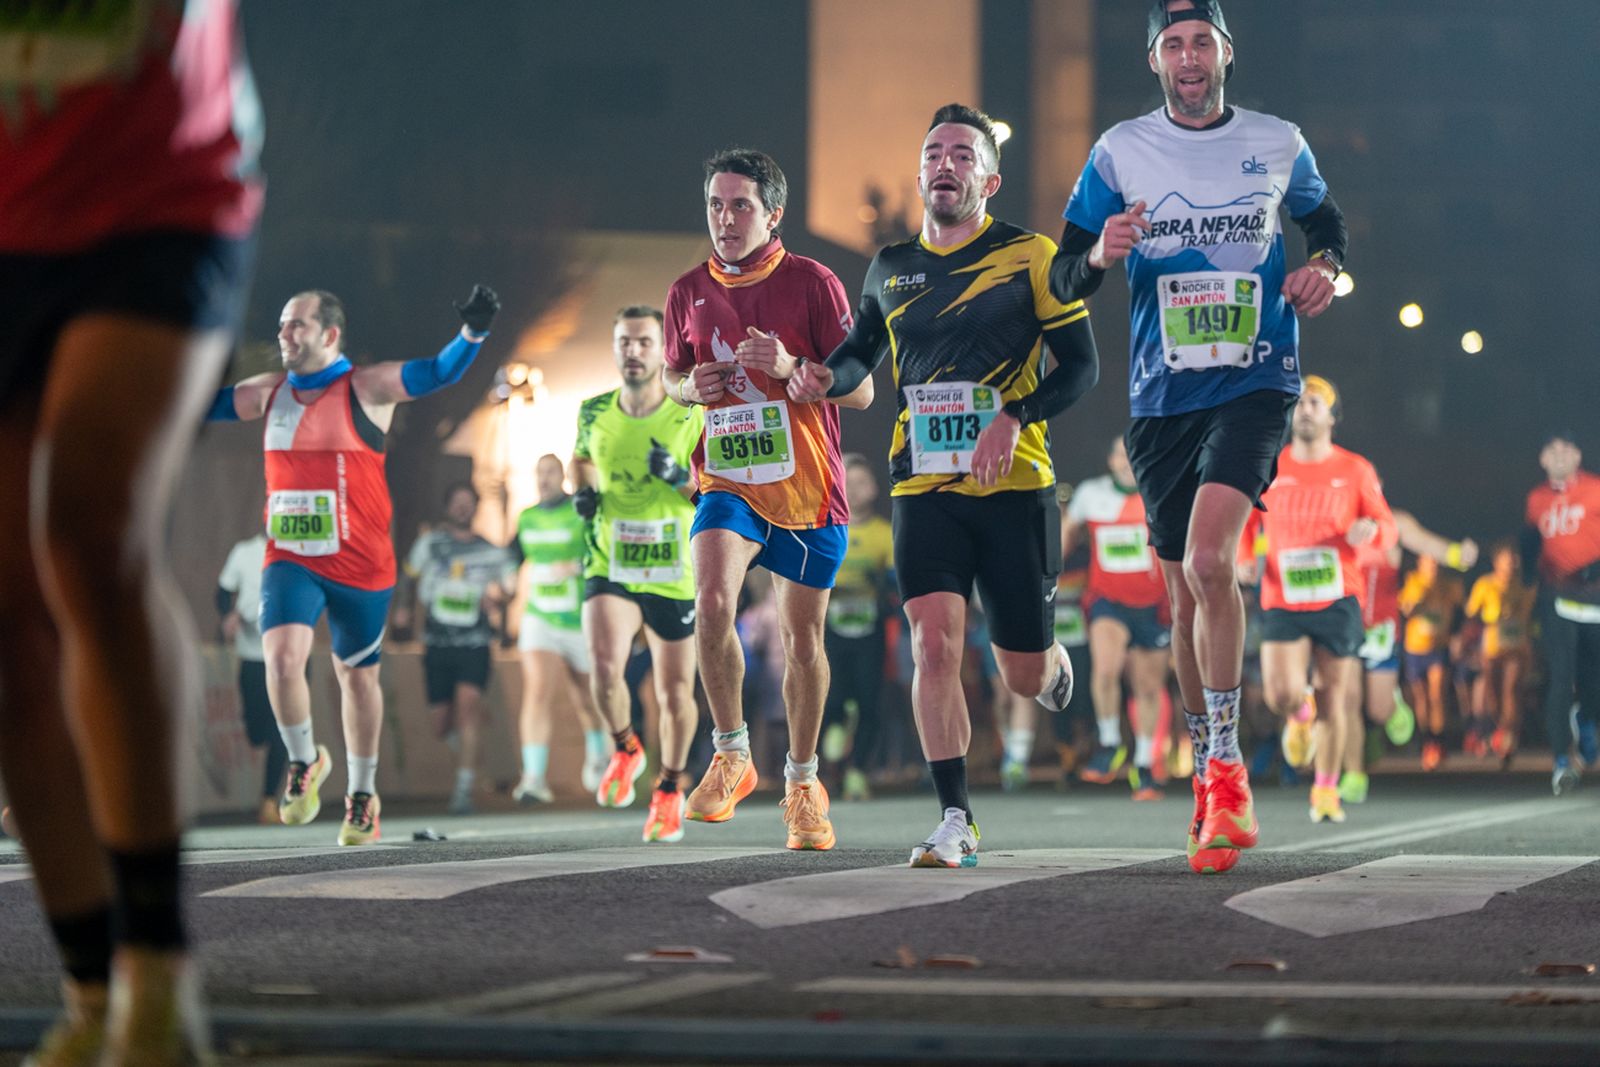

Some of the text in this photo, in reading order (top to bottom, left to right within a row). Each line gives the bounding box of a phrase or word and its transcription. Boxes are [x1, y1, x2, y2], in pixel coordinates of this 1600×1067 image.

[1180, 233, 1219, 248] TRAIL
[1182, 281, 1226, 294] NOCHE DE
[1171, 296, 1193, 307] SAN
[1194, 292, 1226, 305] ANTÓN
[1184, 304, 1242, 335] 1497
[926, 391, 964, 402] NOCHE DE
[919, 403, 935, 414] SAN
[935, 401, 965, 413] ANTÓN
[745, 412, 755, 421] DE
[928, 413, 981, 442] 8173
[720, 431, 774, 460] 9316
[280, 514, 323, 535] 8750
[622, 542, 672, 562] 12748
